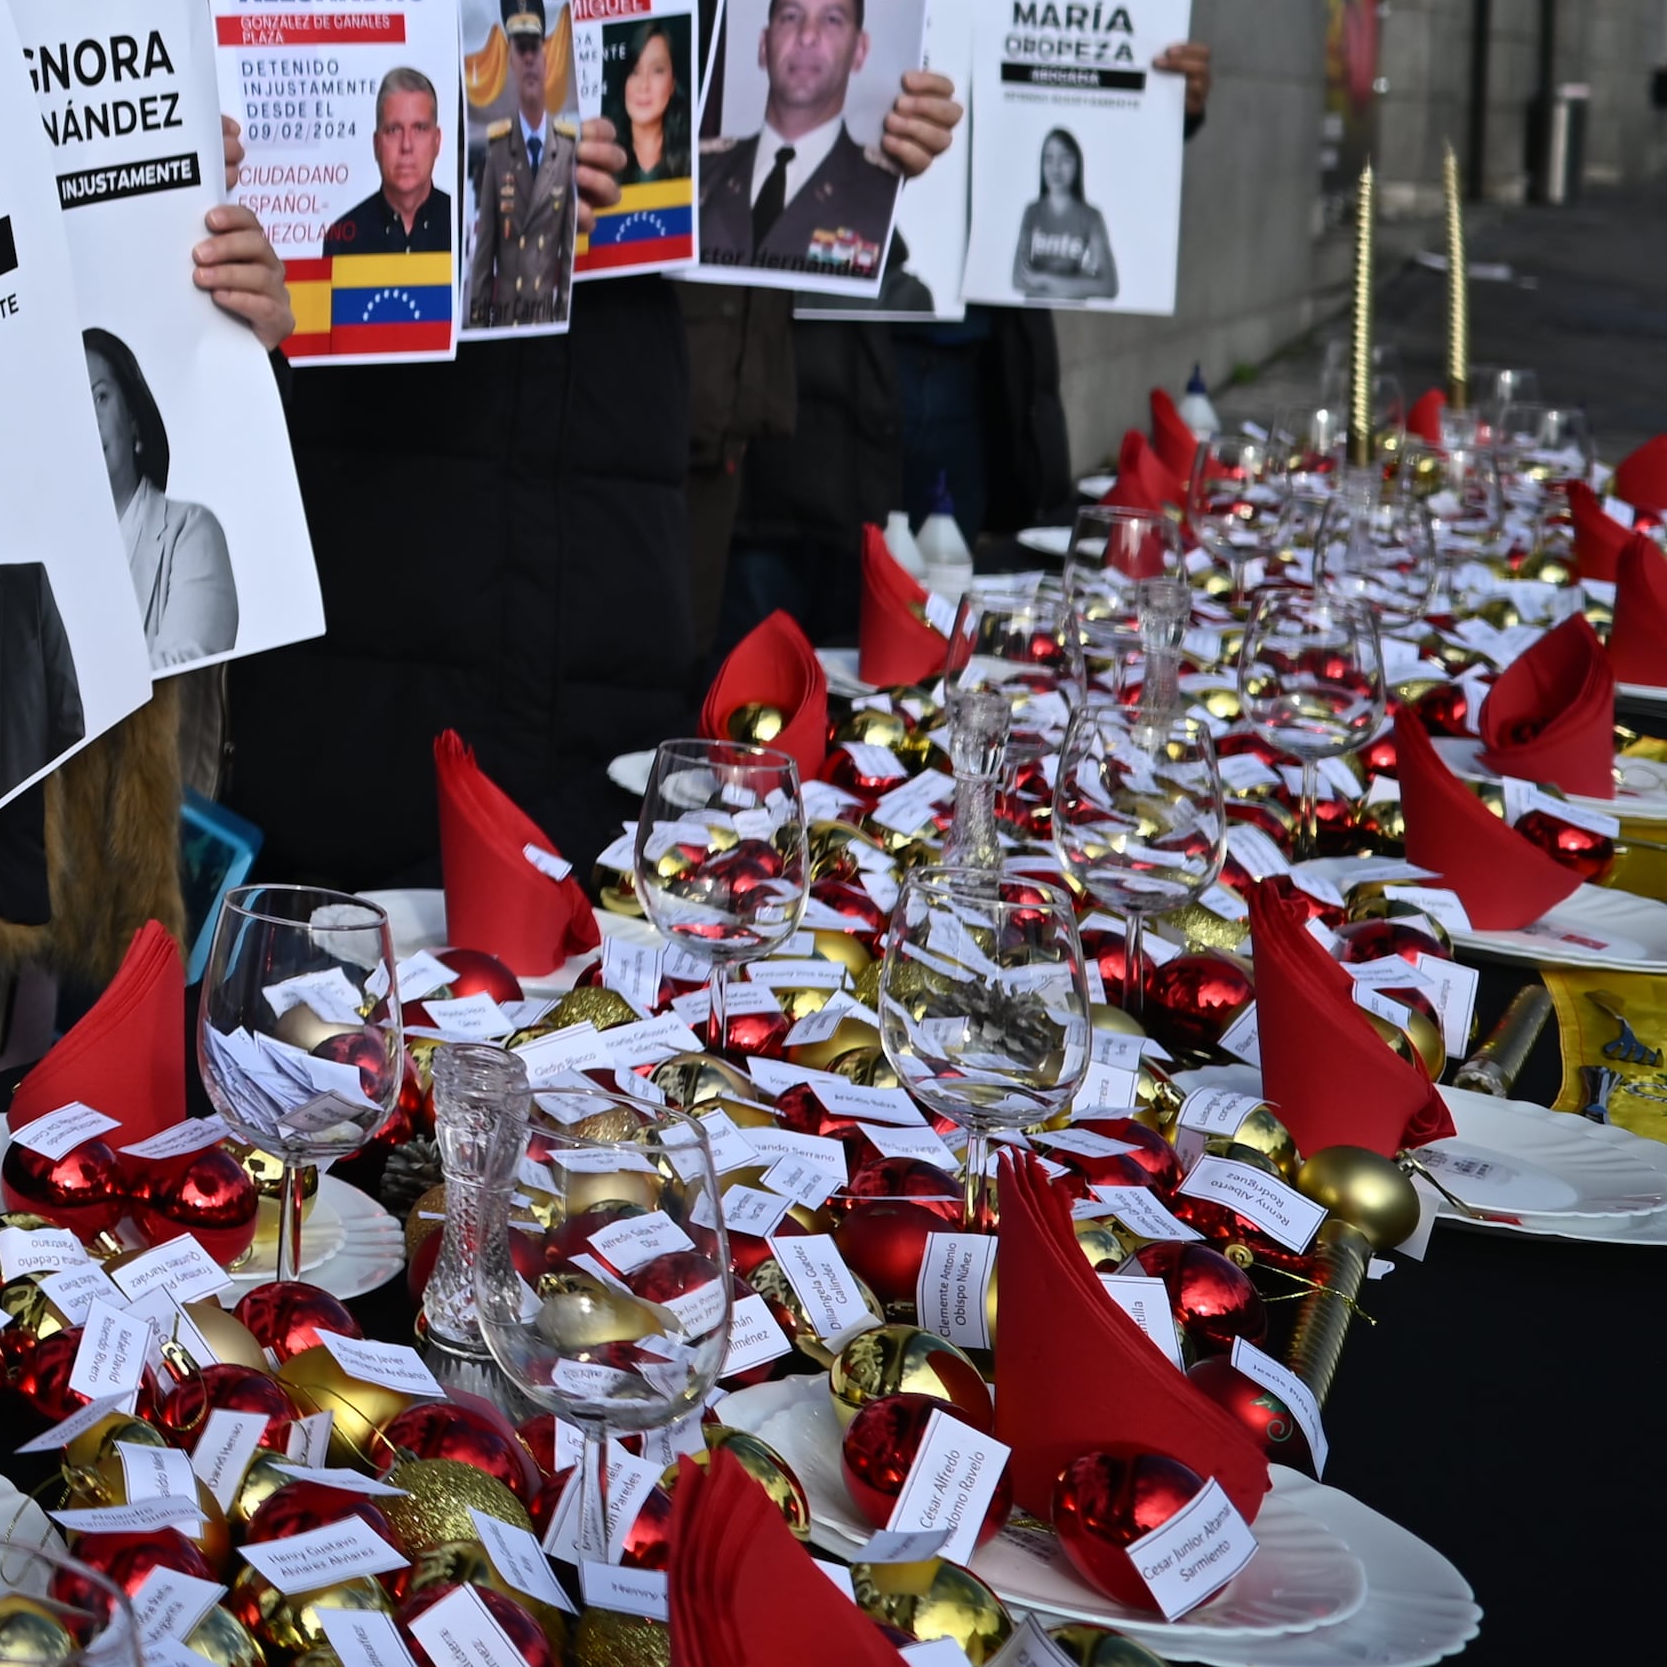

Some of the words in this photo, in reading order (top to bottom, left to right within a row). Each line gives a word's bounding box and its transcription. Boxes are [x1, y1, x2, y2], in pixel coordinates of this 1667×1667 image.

[242, 30, 285, 45] PLAZA
[313, 14, 331, 30] DE
[1004, 31, 1135, 63] OROPEZA
[241, 59, 340, 78] DETENIDO
[243, 78, 377, 98] INJUSTAMENTE
[41, 91, 183, 147] NÁNDEZ
[246, 101, 307, 120] DESDE
[315, 101, 335, 119] EL
[248, 120, 357, 142] 09/02/2024
[61, 158, 193, 202] INJUSTAMENTE
[238, 162, 349, 187] CIUDADANO
[1210, 1179, 1257, 1202] Alberto
[1226, 1171, 1285, 1208] Rodríguez
[1254, 1197, 1291, 1228] Renny
[17, 1254, 60, 1268] Cedeño
[31, 1238, 75, 1252] Pastrano
[940, 1241, 958, 1281] Antonio
[957, 1251, 973, 1284] Núñez
[938, 1280, 952, 1338] Clemente
[953, 1283, 969, 1327] Obispo
[108, 1352, 127, 1384] David
[208, 1452, 228, 1489] David
[963, 1450, 986, 1491] Ravelo
[614, 1471, 644, 1513] Paredes
[919, 1493, 944, 1530] César
[933, 1448, 962, 1495] Alfredo
[267, 1548, 307, 1567] Henry
[307, 1534, 359, 1563] Gustavo
[1142, 1554, 1176, 1581] Cesar
[1173, 1527, 1206, 1562] Junior
[1203, 1501, 1235, 1537] Altamar
[1178, 1538, 1232, 1583] Sarmiento
